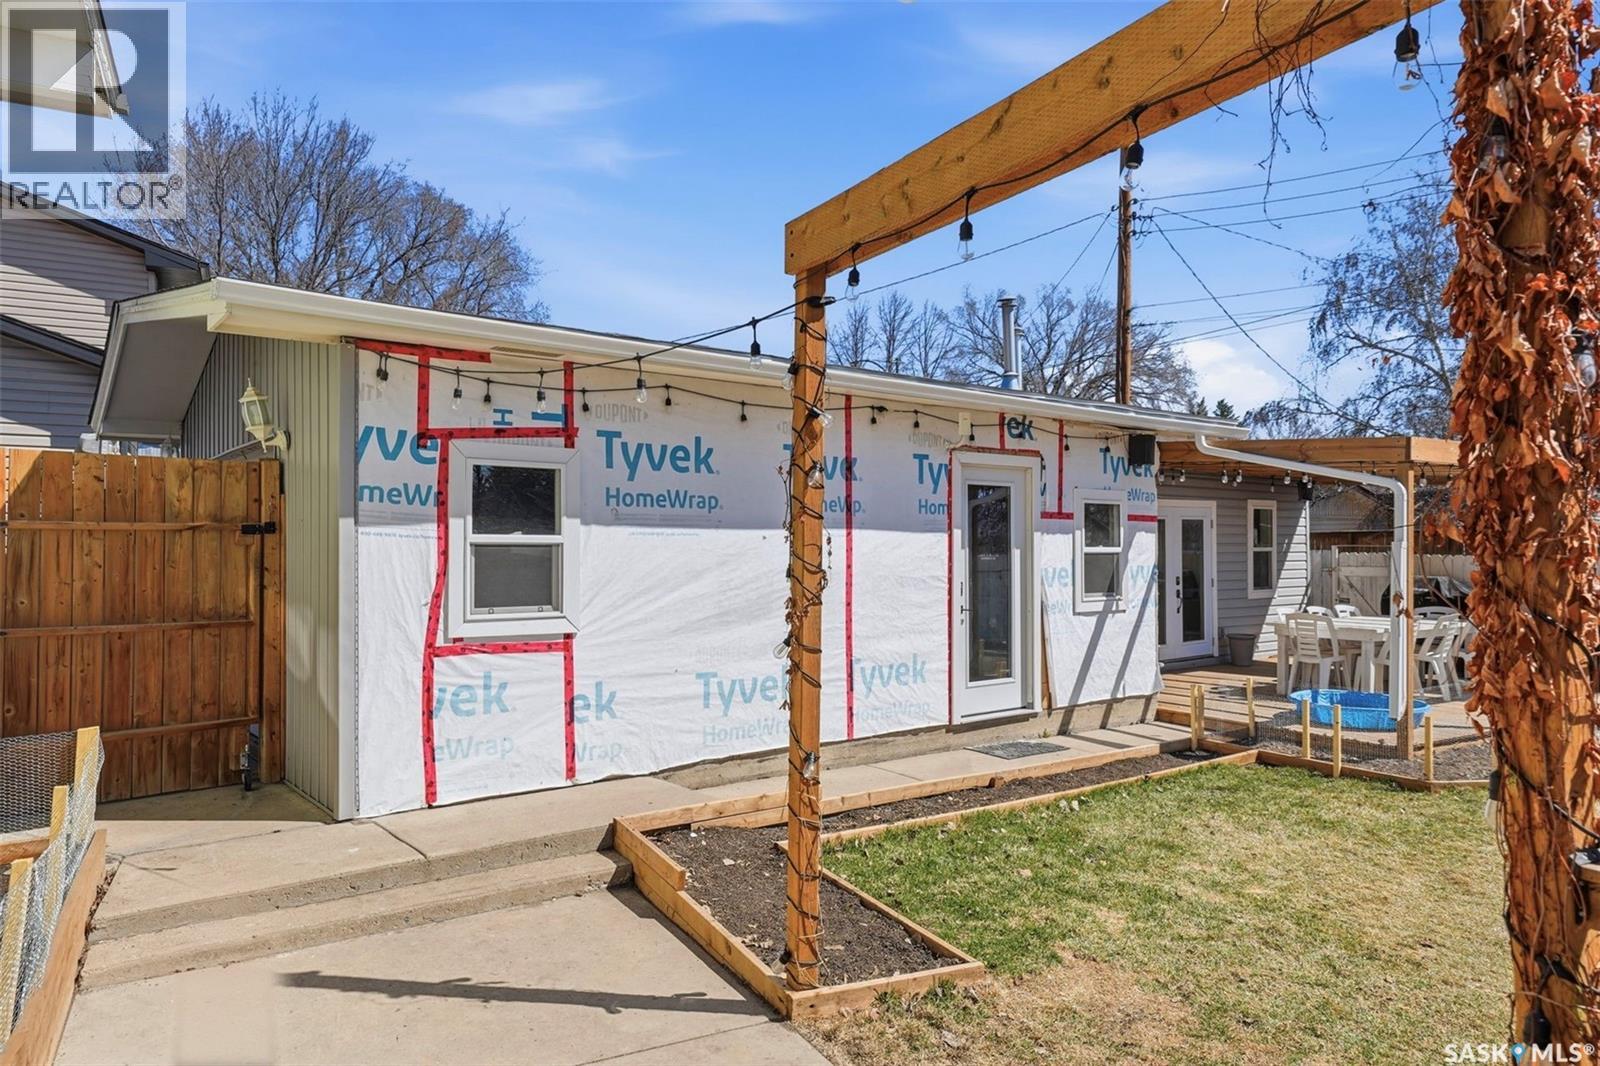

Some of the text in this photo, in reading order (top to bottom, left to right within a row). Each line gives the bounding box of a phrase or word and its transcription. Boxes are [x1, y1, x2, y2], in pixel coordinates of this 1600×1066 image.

[596, 429, 715, 482] Tyvek
[605, 486, 719, 514] HomeWrap
[854, 652, 927, 700] yvek
